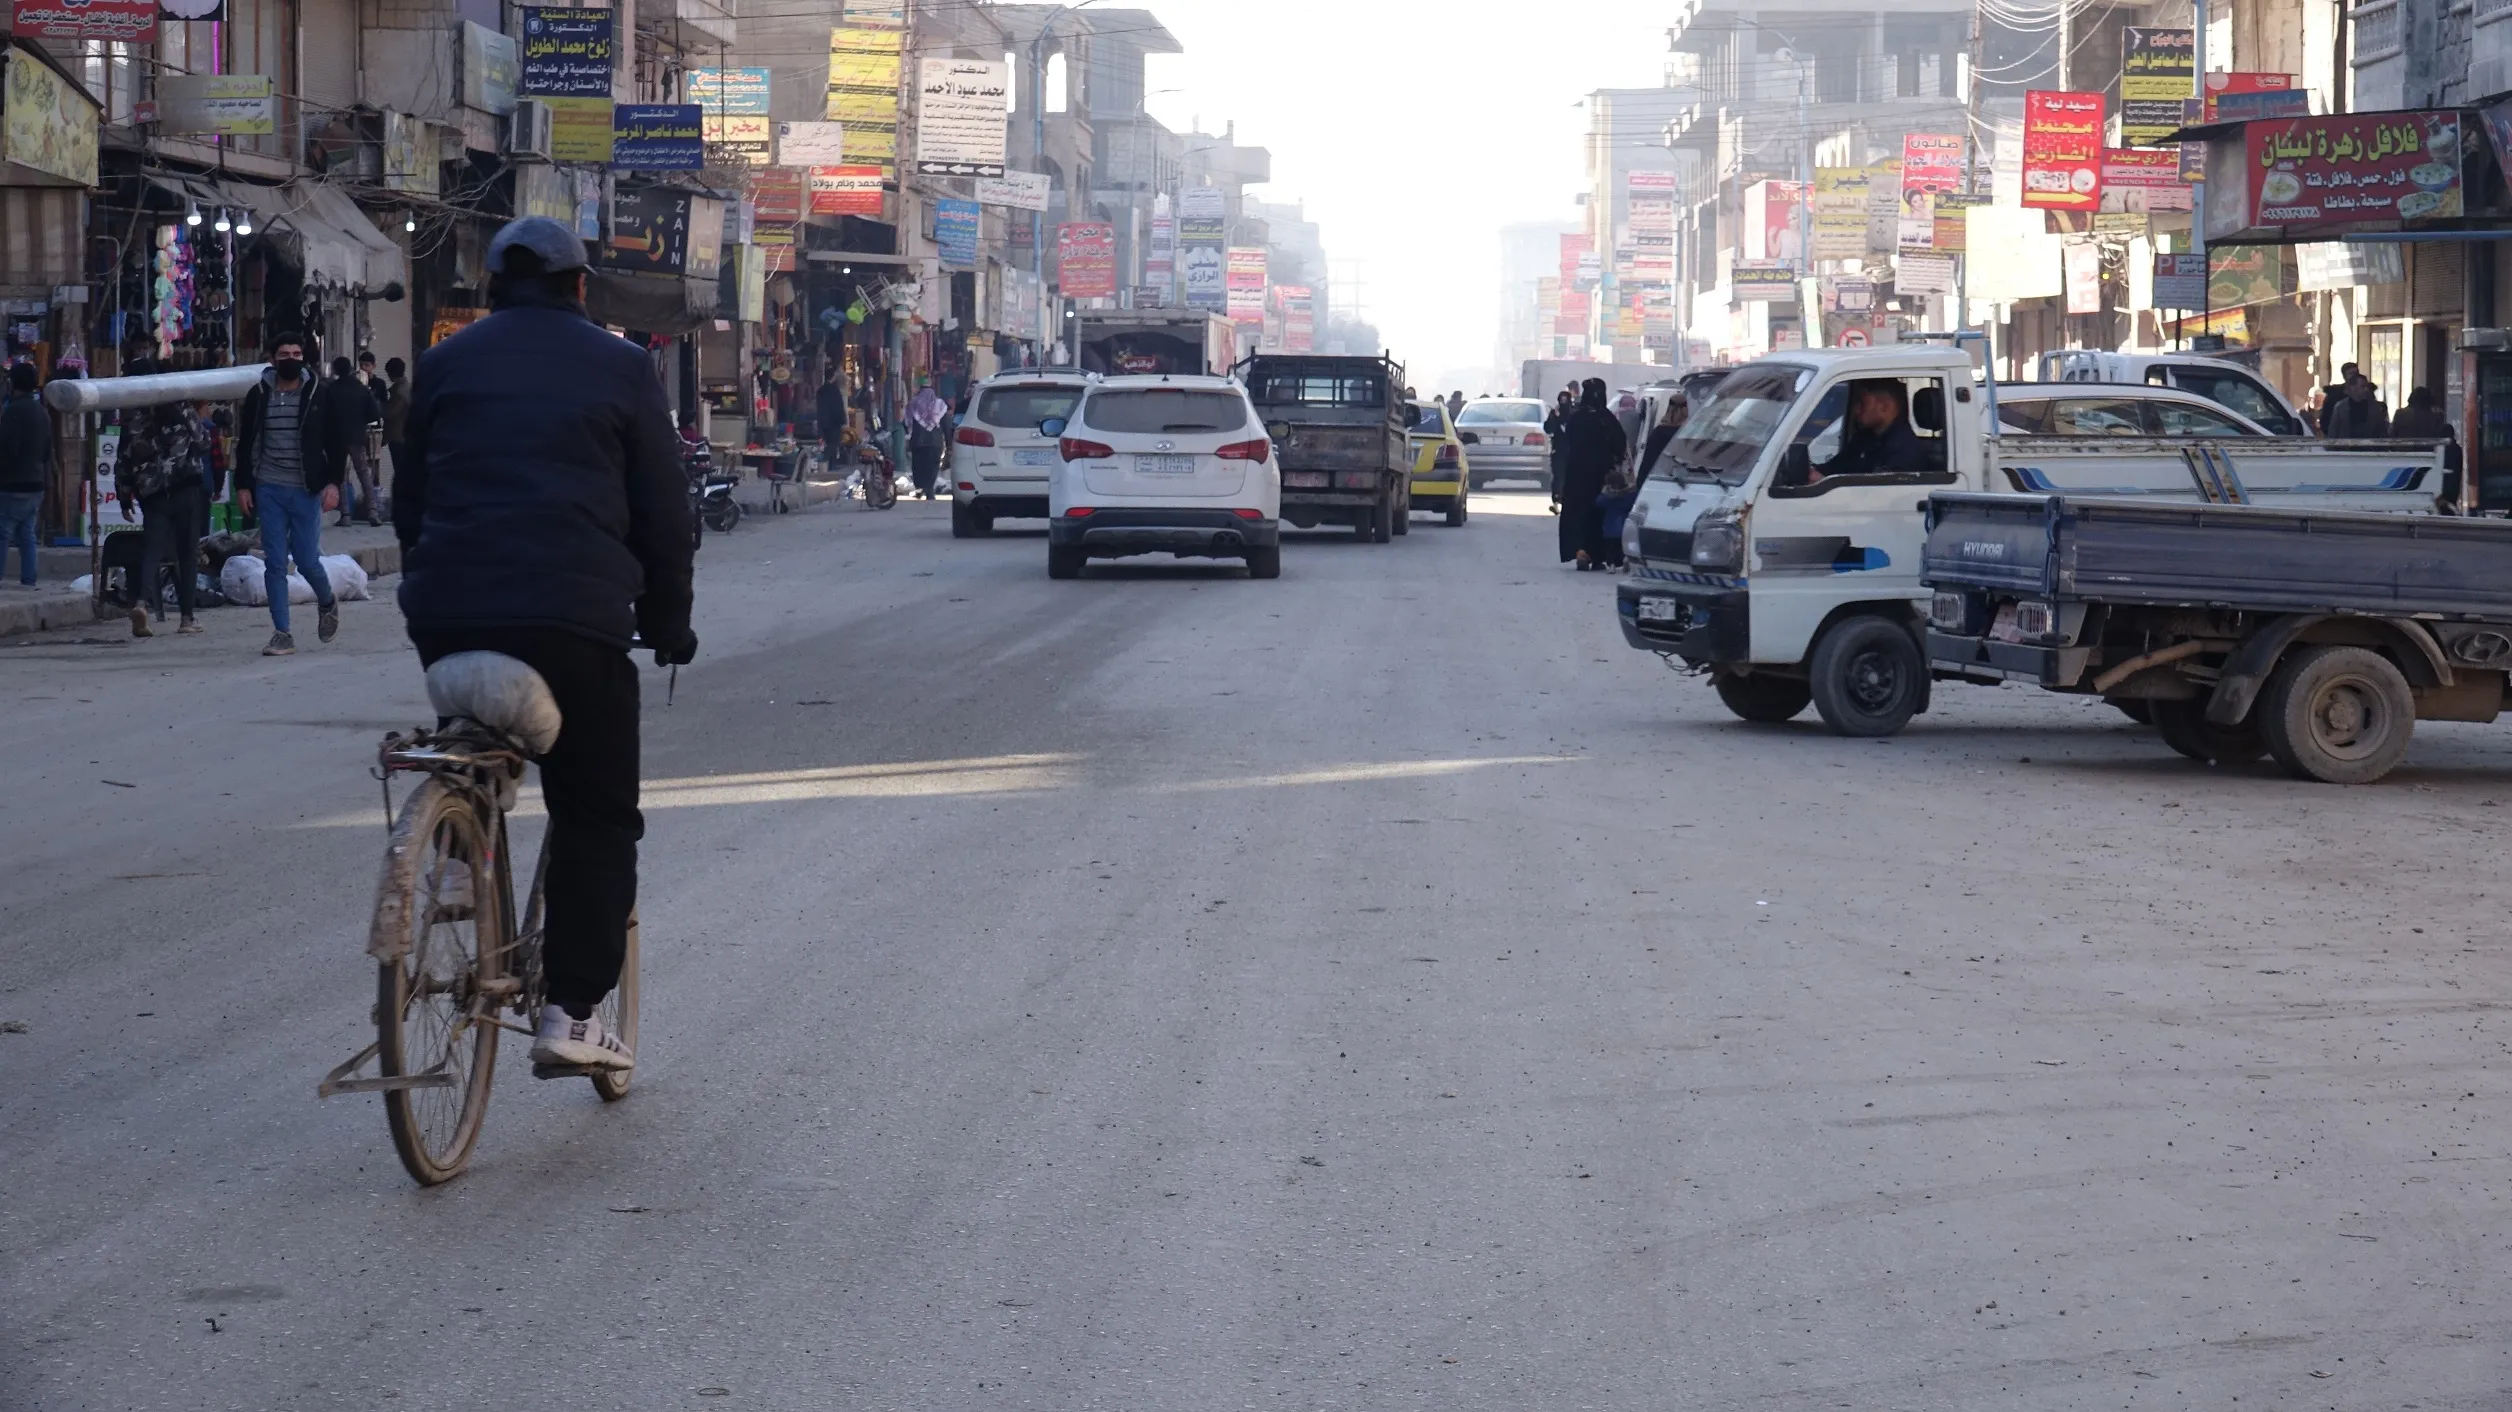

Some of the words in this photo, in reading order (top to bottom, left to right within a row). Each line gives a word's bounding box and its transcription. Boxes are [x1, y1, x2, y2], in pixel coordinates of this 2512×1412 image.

[540, 8, 574, 21] السنية
[575, 10, 610, 22] العيادة
[549, 22, 597, 33] الدكتورة
[526, 36, 560, 58] الطويل
[561, 39, 586, 54] محمد
[526, 63, 543, 75] الفم
[543, 63, 559, 76] طب
[558, 63, 569, 78] في
[569, 63, 610, 76] اختصاصية
[949, 64, 990, 76] الدكتور
[525, 78, 569, 92] وجراحتها
[980, 84, 1005, 97] محمد
[2044, 96, 2097, 113] صيدلية
[630, 109, 680, 120] الدكتور
[673, 126, 700, 138] محمد
[2030, 119, 2094, 135] محمد
[1909, 137, 1960, 149] صالون
[2315, 125, 2364, 165] زهرة
[2367, 122, 2420, 162] فلافل
[2260, 130, 2314, 168] لبنان
[857, 179, 883, 189] محمد
[671, 200, 685, 265] ZAIN
[2157, 256, 2172, 274] P
[1963, 541, 2004, 558] HYUNDAI
